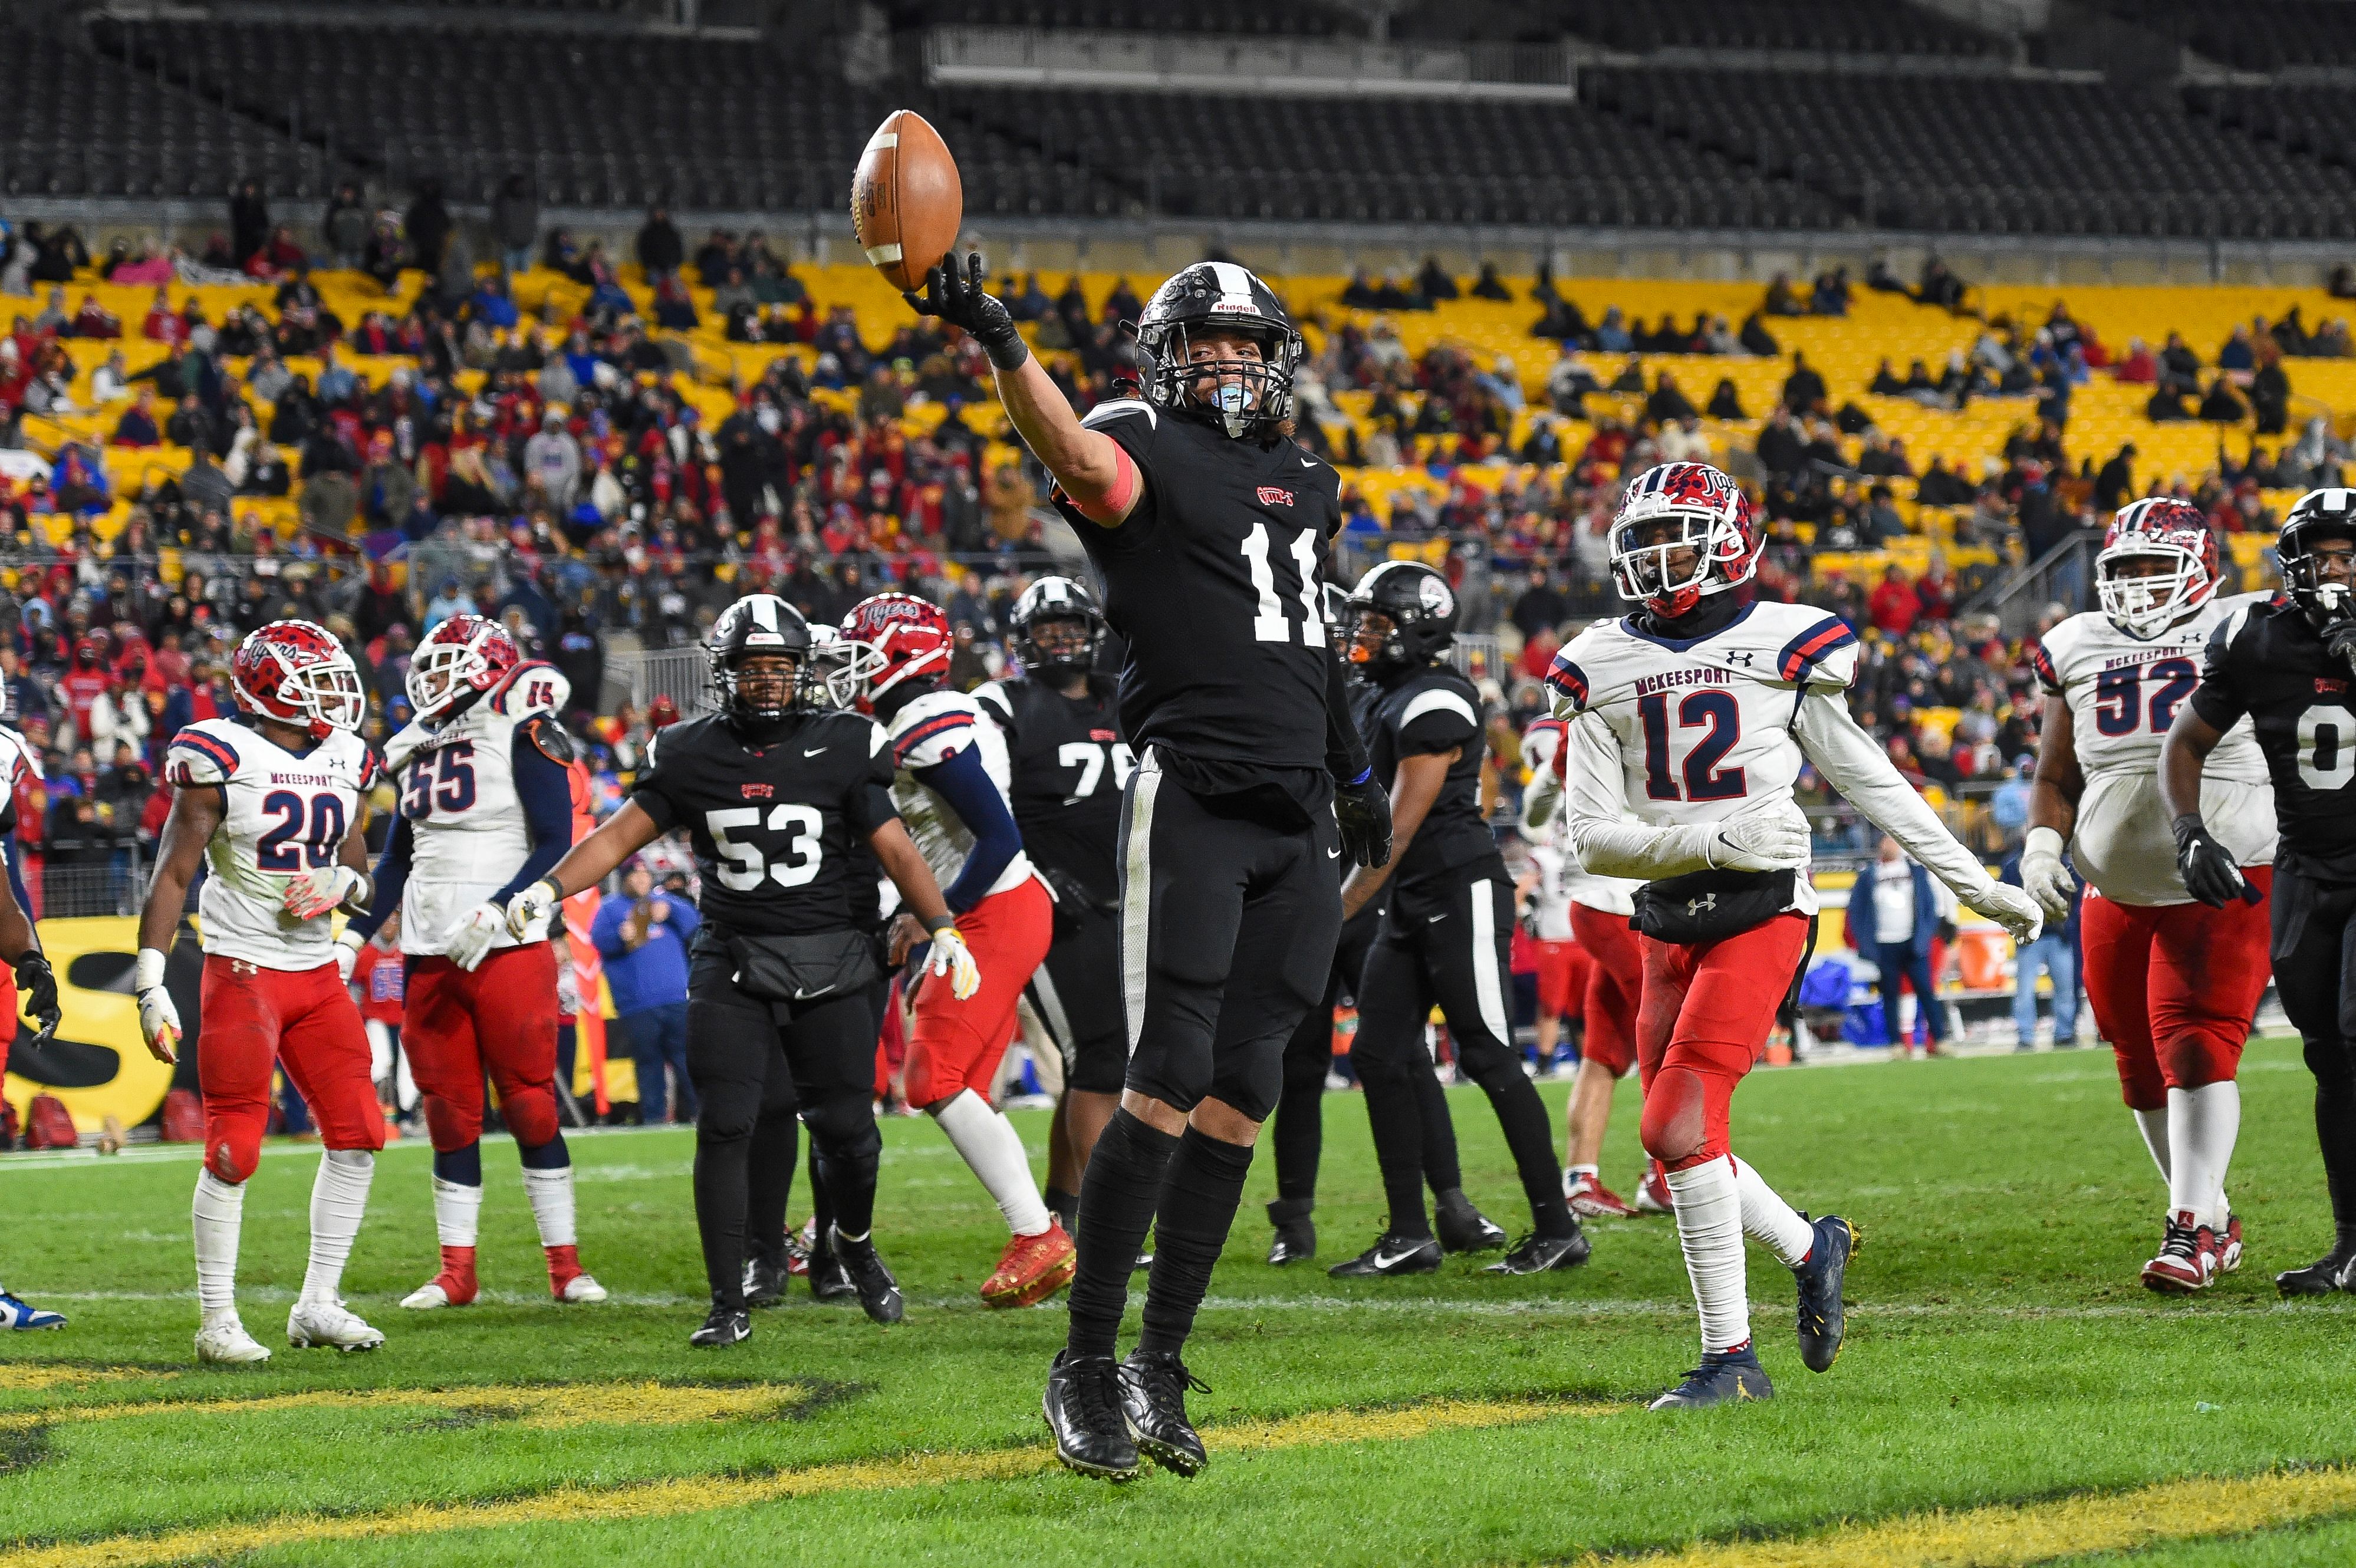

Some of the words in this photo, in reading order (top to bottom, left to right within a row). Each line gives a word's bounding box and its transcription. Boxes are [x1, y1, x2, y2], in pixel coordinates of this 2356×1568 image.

[1218, 304, 1255, 313] Riddell
[1697, 468, 1741, 503] Tige
[1240, 522, 1326, 648] 11
[858, 600, 920, 632] Tigers
[239, 634, 300, 670] Tigrs
[1634, 668, 1732, 697] MCKEESPORT
[1637, 689, 1748, 802] 12
[2297, 704, 2356, 789] 0
[271, 773, 332, 786] MCKEESPORT
[404, 738, 477, 821] 55
[256, 789, 345, 872] 20
[706, 803, 823, 891] 53
